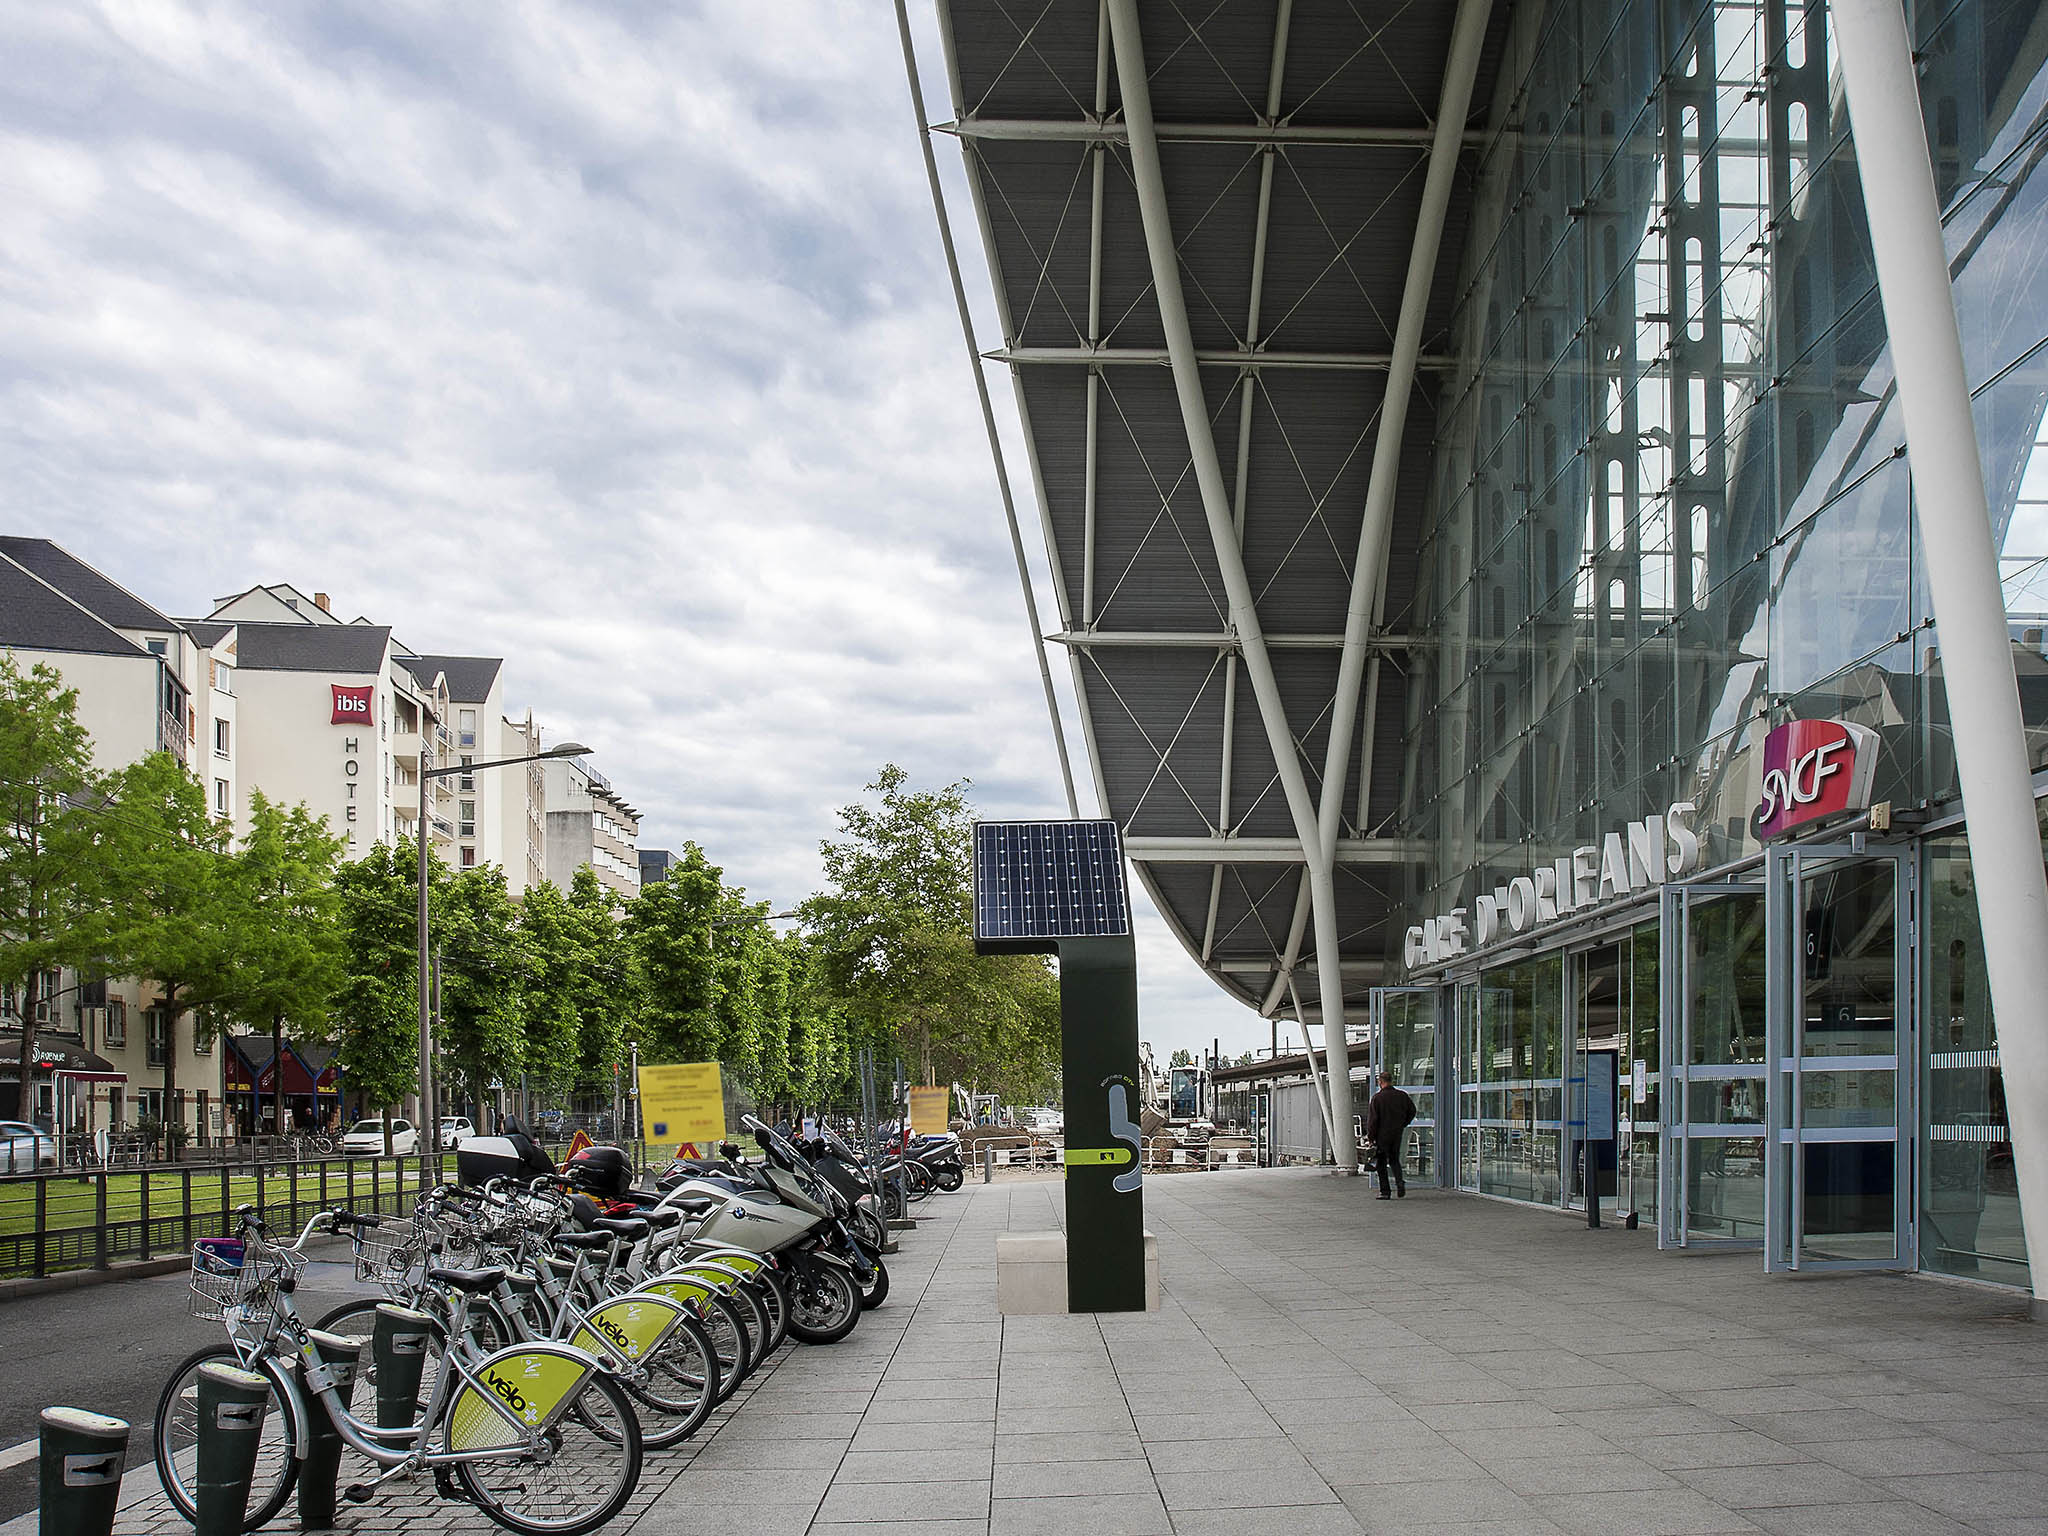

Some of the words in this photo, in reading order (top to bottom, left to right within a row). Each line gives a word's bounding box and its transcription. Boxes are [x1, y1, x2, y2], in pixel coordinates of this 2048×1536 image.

[337, 695, 367, 712] ibis
[344, 737, 359, 845] HOTEL
[1758, 738, 1847, 824] SNCF
[1404, 907, 1468, 969] GARE
[1806, 933, 1815, 955] 6
